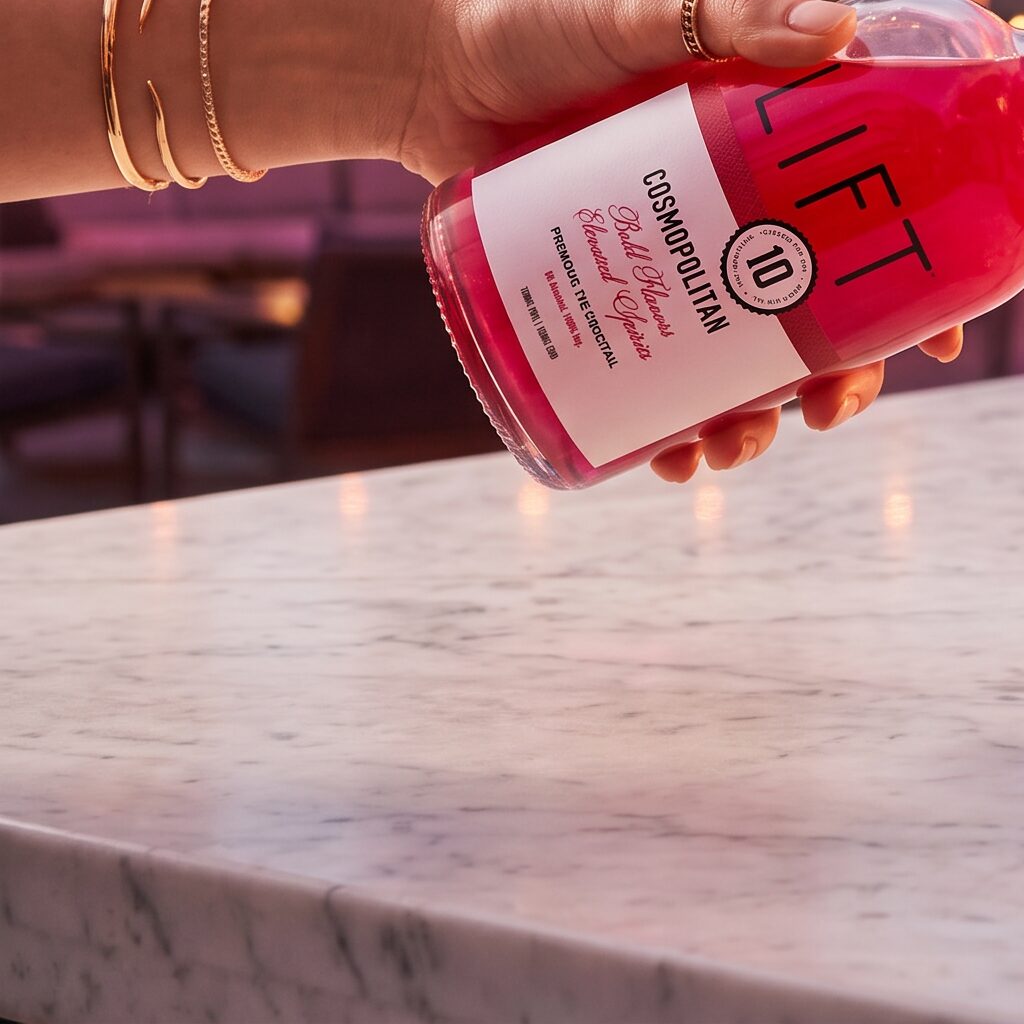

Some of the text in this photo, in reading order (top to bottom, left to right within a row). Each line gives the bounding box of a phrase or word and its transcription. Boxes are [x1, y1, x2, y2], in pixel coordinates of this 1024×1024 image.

[642, 168, 730, 335] COSMOPOLITAN
[755, 62, 933, 286] LIFT
[746, 244, 794, 289] 10
